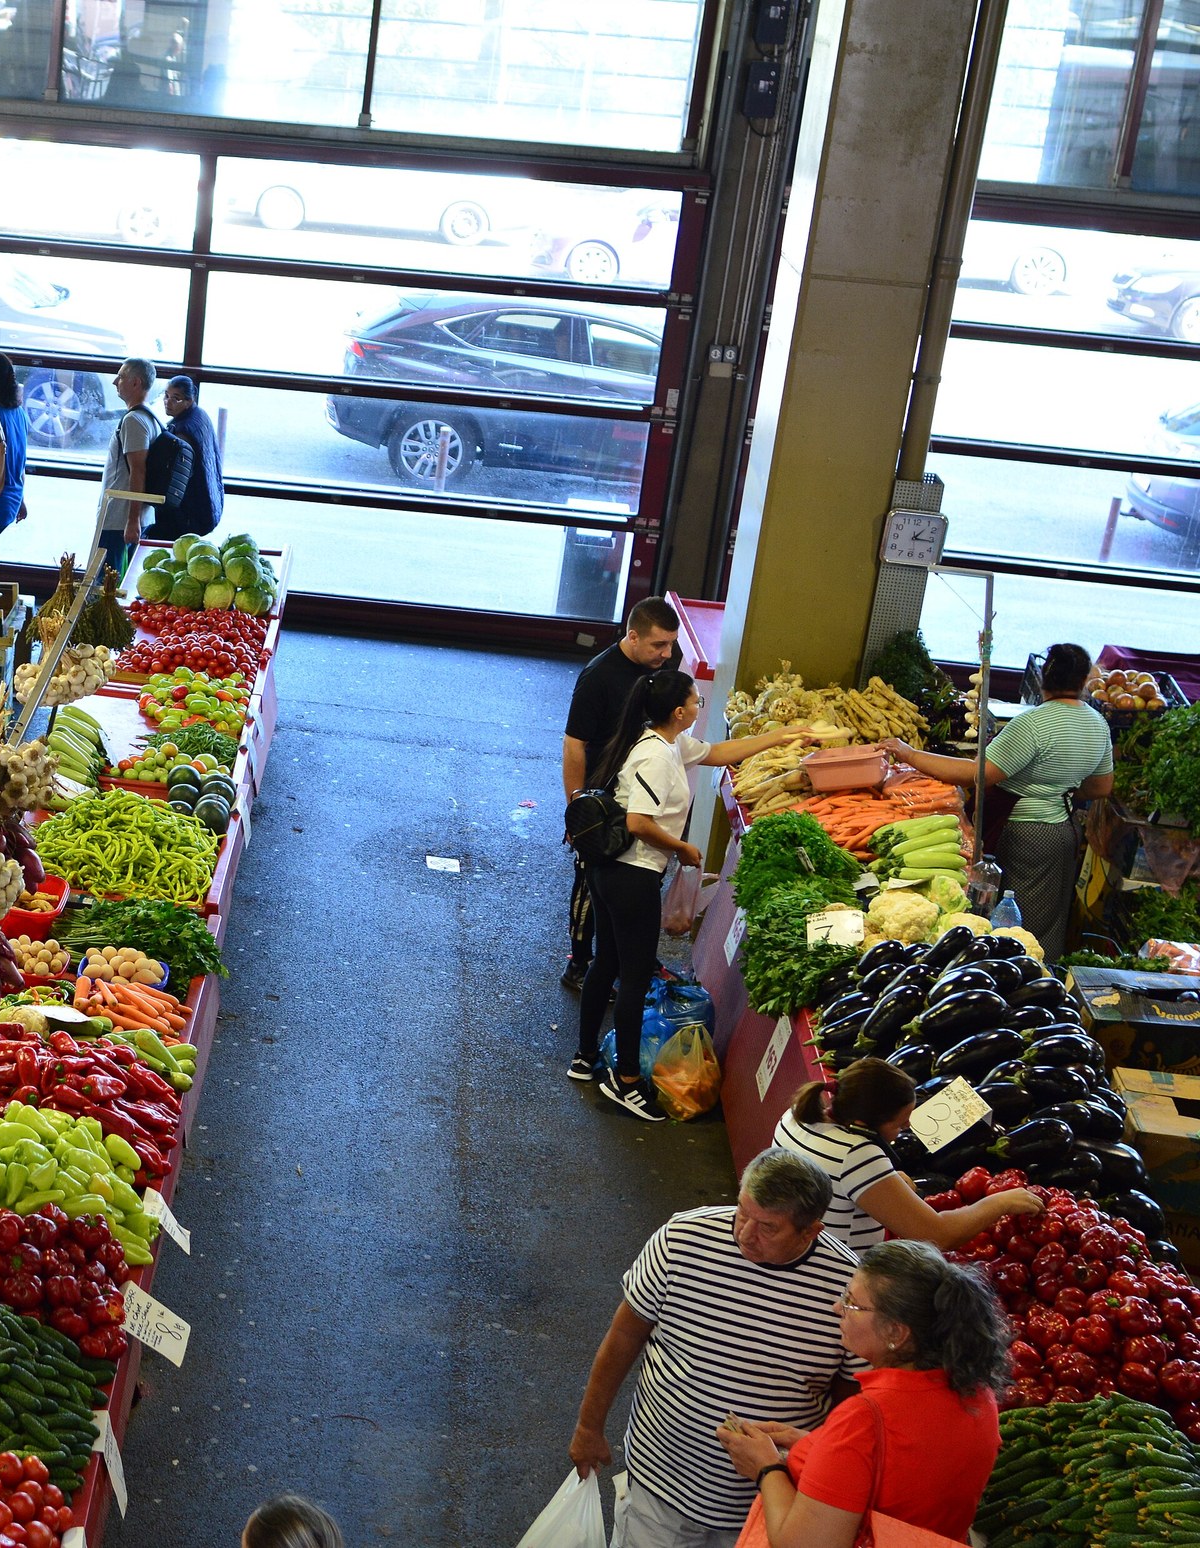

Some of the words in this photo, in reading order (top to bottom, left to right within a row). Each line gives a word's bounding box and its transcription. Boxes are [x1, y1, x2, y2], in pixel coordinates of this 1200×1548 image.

[893, 532, 899, 540] 9
[930, 526, 937, 534] 2
[910, 1103, 951, 1136] 3
[155, 1322, 182, 1340] 8
